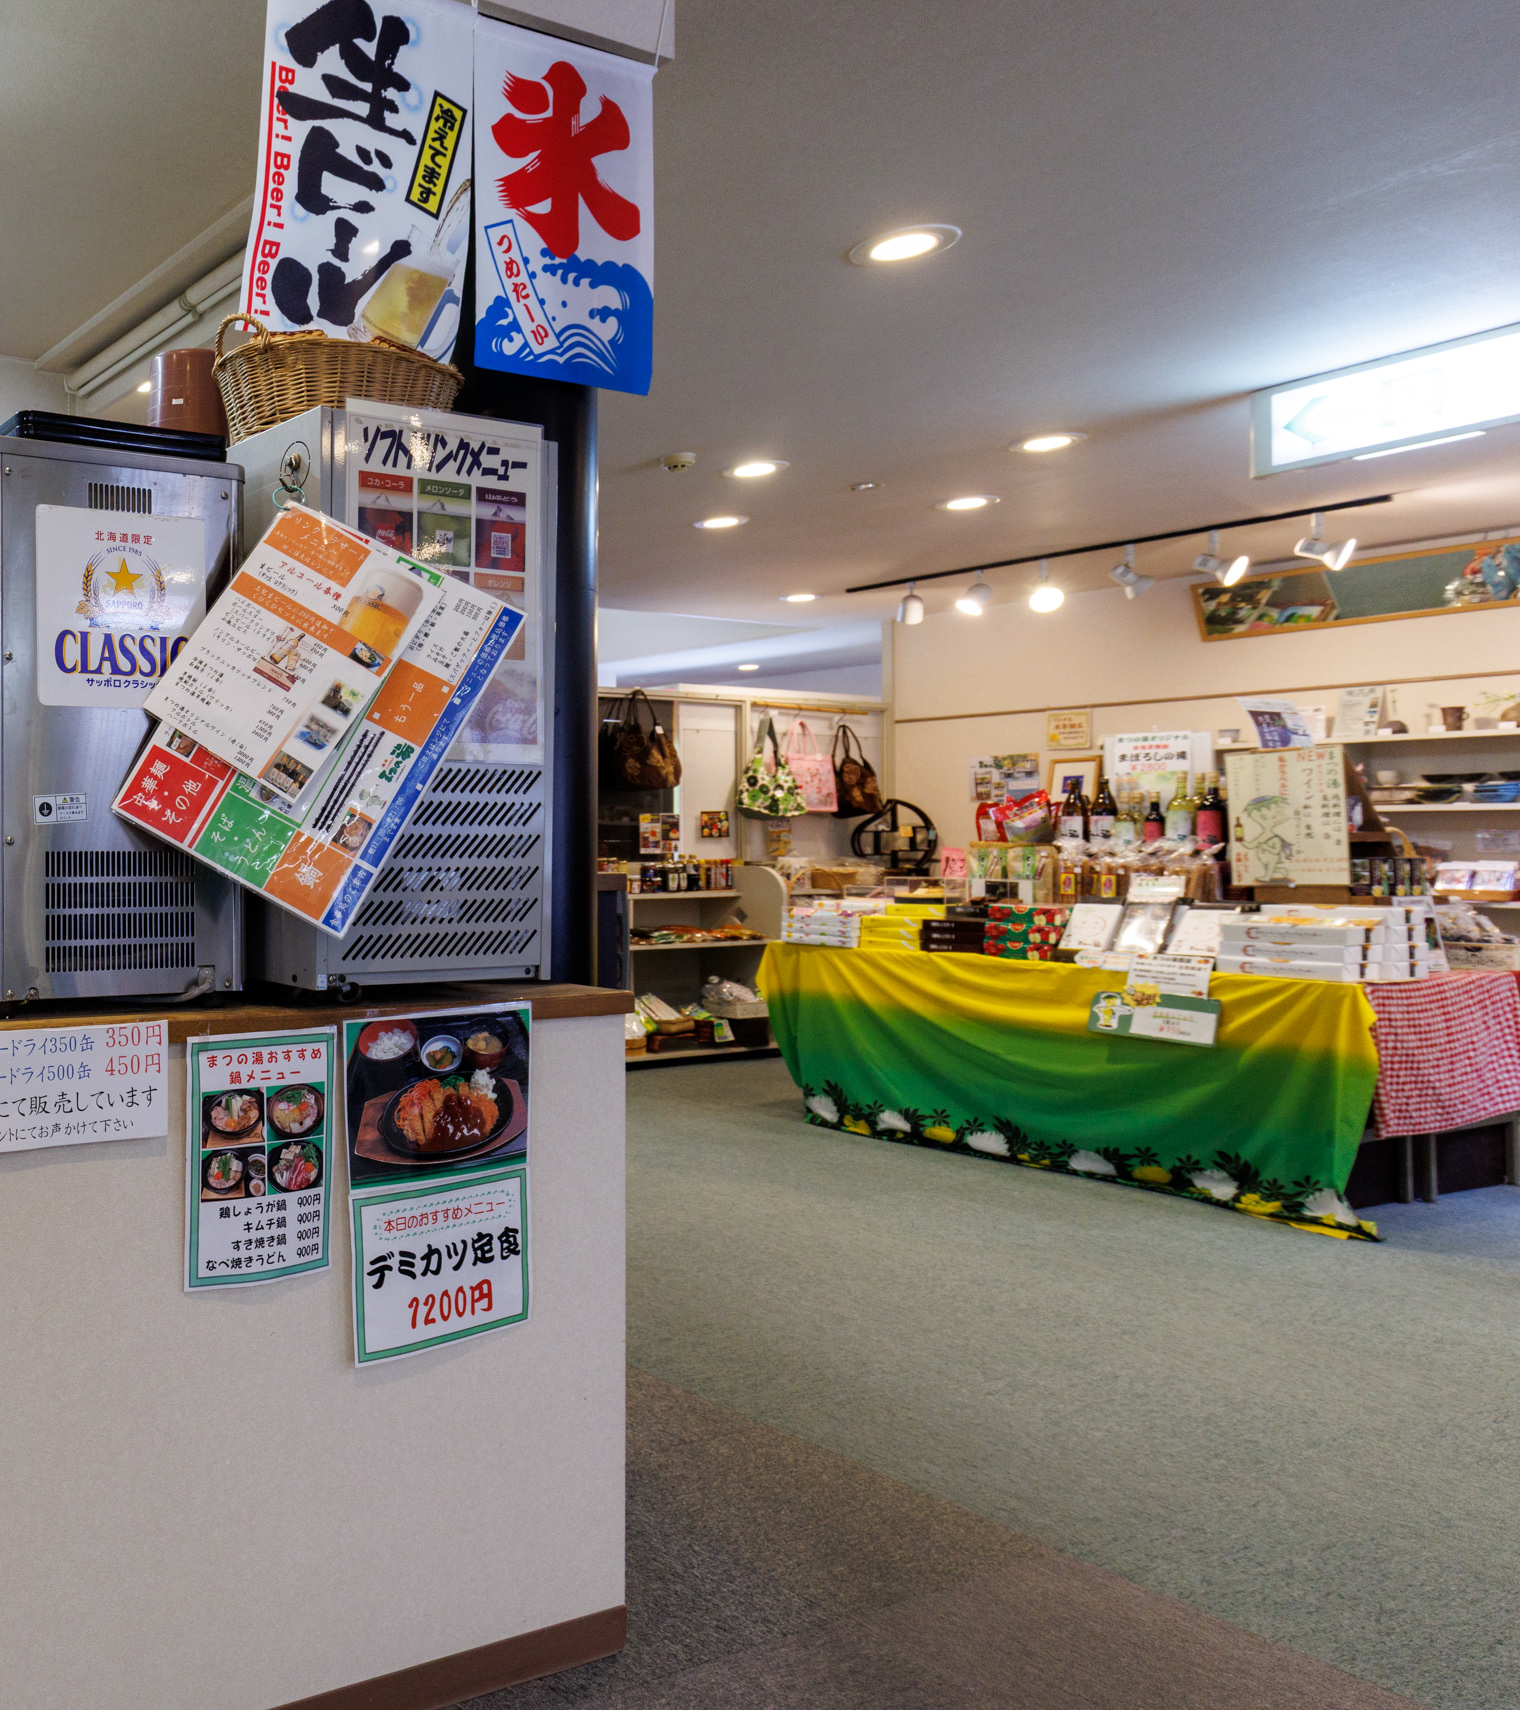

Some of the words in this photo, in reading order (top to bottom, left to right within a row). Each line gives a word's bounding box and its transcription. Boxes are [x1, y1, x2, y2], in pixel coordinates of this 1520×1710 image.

[270, 0, 417, 326] 生ビール
[415, 102, 459, 207] 冷えてます
[491, 61, 641, 259] 氷
[266, 150, 291, 230] Beer!
[253, 237, 281, 318] Beer!
[495, 233, 550, 346] つめたーい
[367, 477, 406, 490] コカ・コーラ
[425, 485, 465, 497] メロンソーダ
[95, 530, 153, 546] 北海道限定
[106, 545, 127, 554] SINCE
[299, 530, 338, 558] メニュー
[258, 561, 286, 581] 生ビール
[330, 602, 350, 617] 500円
[277, 559, 342, 602] アルコール各種
[105, 600, 143, 610] SAPPORO
[425, 642, 439, 660] ライス
[86, 677, 159, 691] サッポロクラシッ
[392, 678, 425, 726] もう一品
[1296, 751, 1327, 762] NEW
[129, 756, 171, 810] 中華麺
[160, 775, 203, 829] その他
[206, 811, 237, 846] そば
[232, 823, 268, 869] うどん
[291, 859, 324, 891] 鍋
[105, 1024, 163, 1048] 350円
[104, 1052, 161, 1078] 450円
[205, 1047, 322, 1069] まつの湯おすすめ
[229, 1070, 302, 1085] 鍋メニュー
[218, 1198, 287, 1220] 鶏しょうが鍋
[296, 1193, 321, 1208] 900円
[242, 1215, 287, 1234] キムチ鍋
[296, 1209, 321, 1225] 900円
[383, 1201, 507, 1235] 本日のおすすめメニュー
[231, 1232, 287, 1252] すき焼き鍋
[296, 1226, 320, 1241] 900円
[205, 1250, 286, 1272] なべ焼きうどん
[296, 1242, 319, 1259] 900円
[366, 1225, 522, 1290] デミカツ定食
[407, 1278, 494, 1330] 1200円
